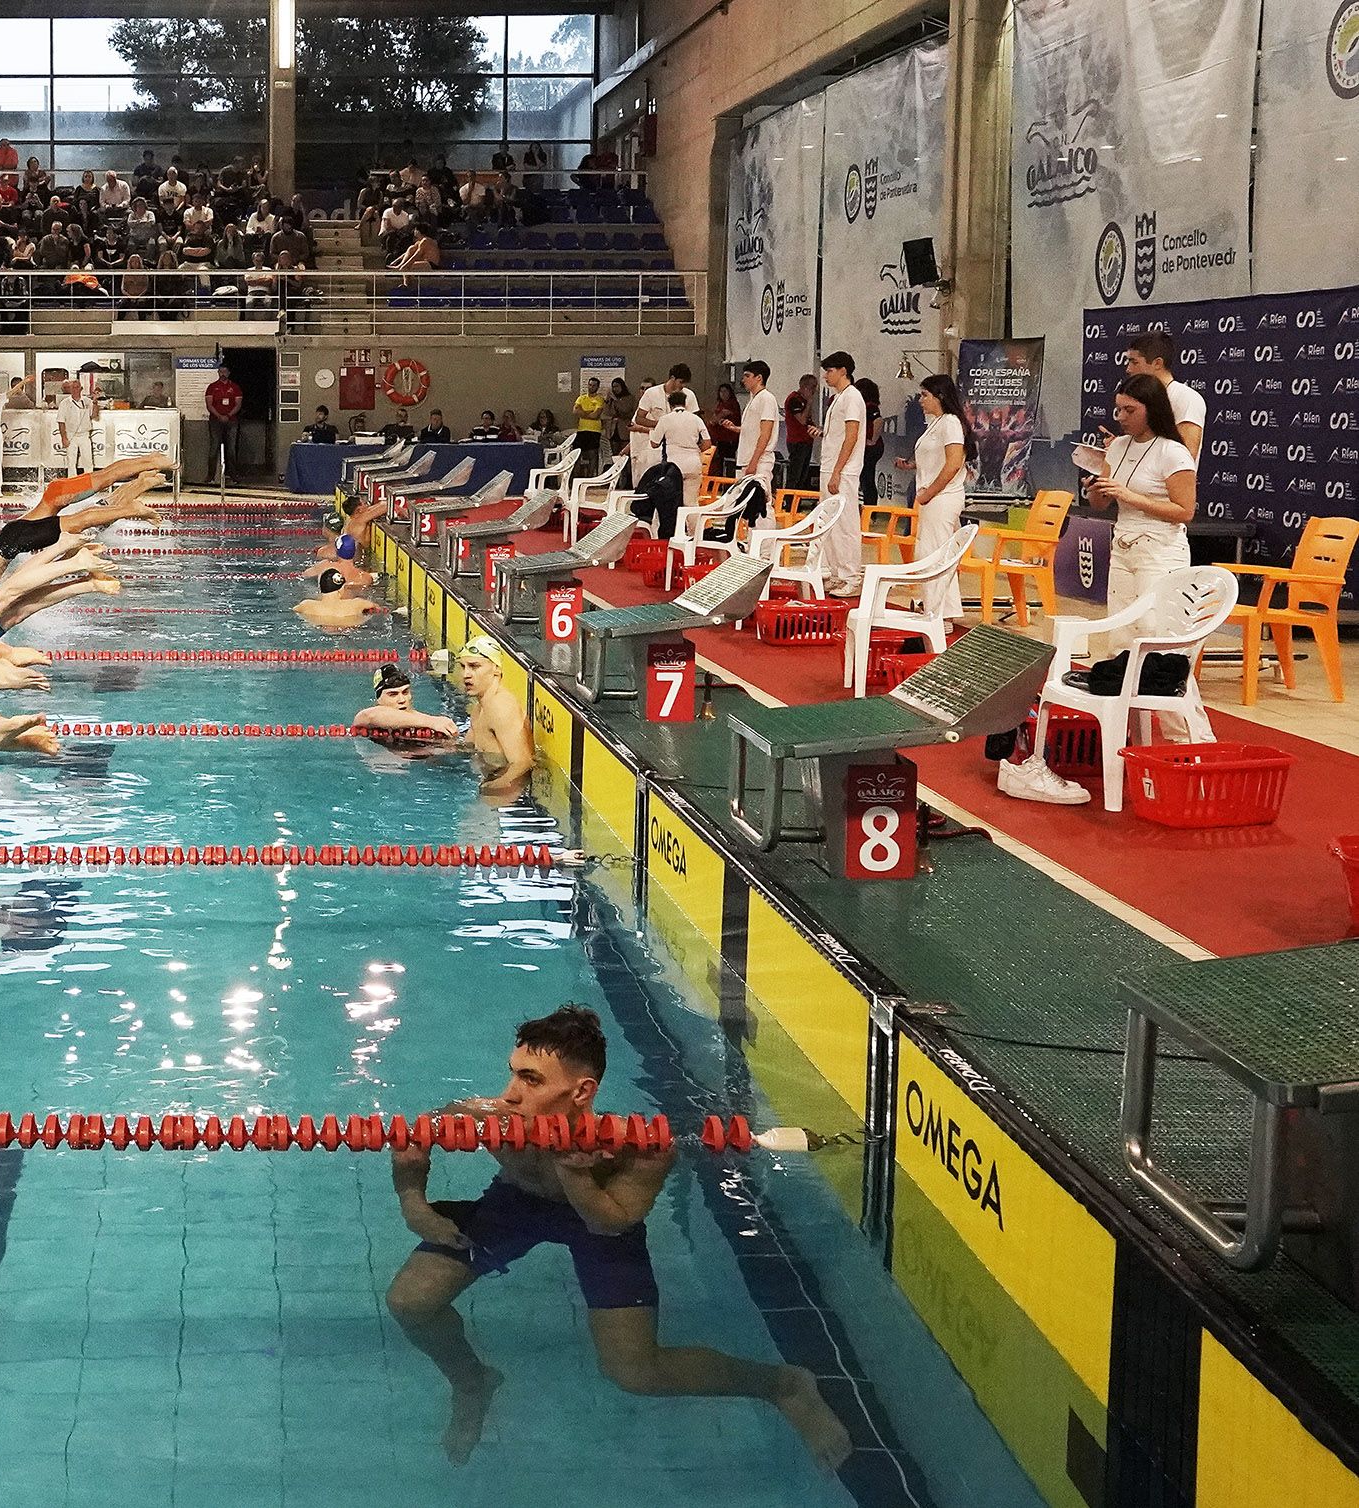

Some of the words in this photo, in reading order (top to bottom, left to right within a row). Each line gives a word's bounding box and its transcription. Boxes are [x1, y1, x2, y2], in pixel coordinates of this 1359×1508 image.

[1162, 229, 1207, 251] Concello
[1162, 257, 1175, 273] de
[1176, 247, 1236, 272] Pontevedr
[969, 368, 994, 377] COPA
[995, 366, 1031, 377] ESPAÑA
[974, 378, 987, 386] DE
[988, 378, 1022, 387] CLUBES
[979, 387, 1027, 396] DIVISIÓN
[117, 442, 169, 450] GALAICO
[377, 485, 387, 501] 1
[421, 513, 431, 532] 3
[551, 602, 573, 638] 6
[653, 660, 687, 668] GALAICO
[656, 672, 684, 717] 7
[857, 789, 905, 798] GALAICO
[858, 805, 901, 872] 8
[650, 817, 688, 883] OMEGA
[904, 1080, 1005, 1232] OMEGA
